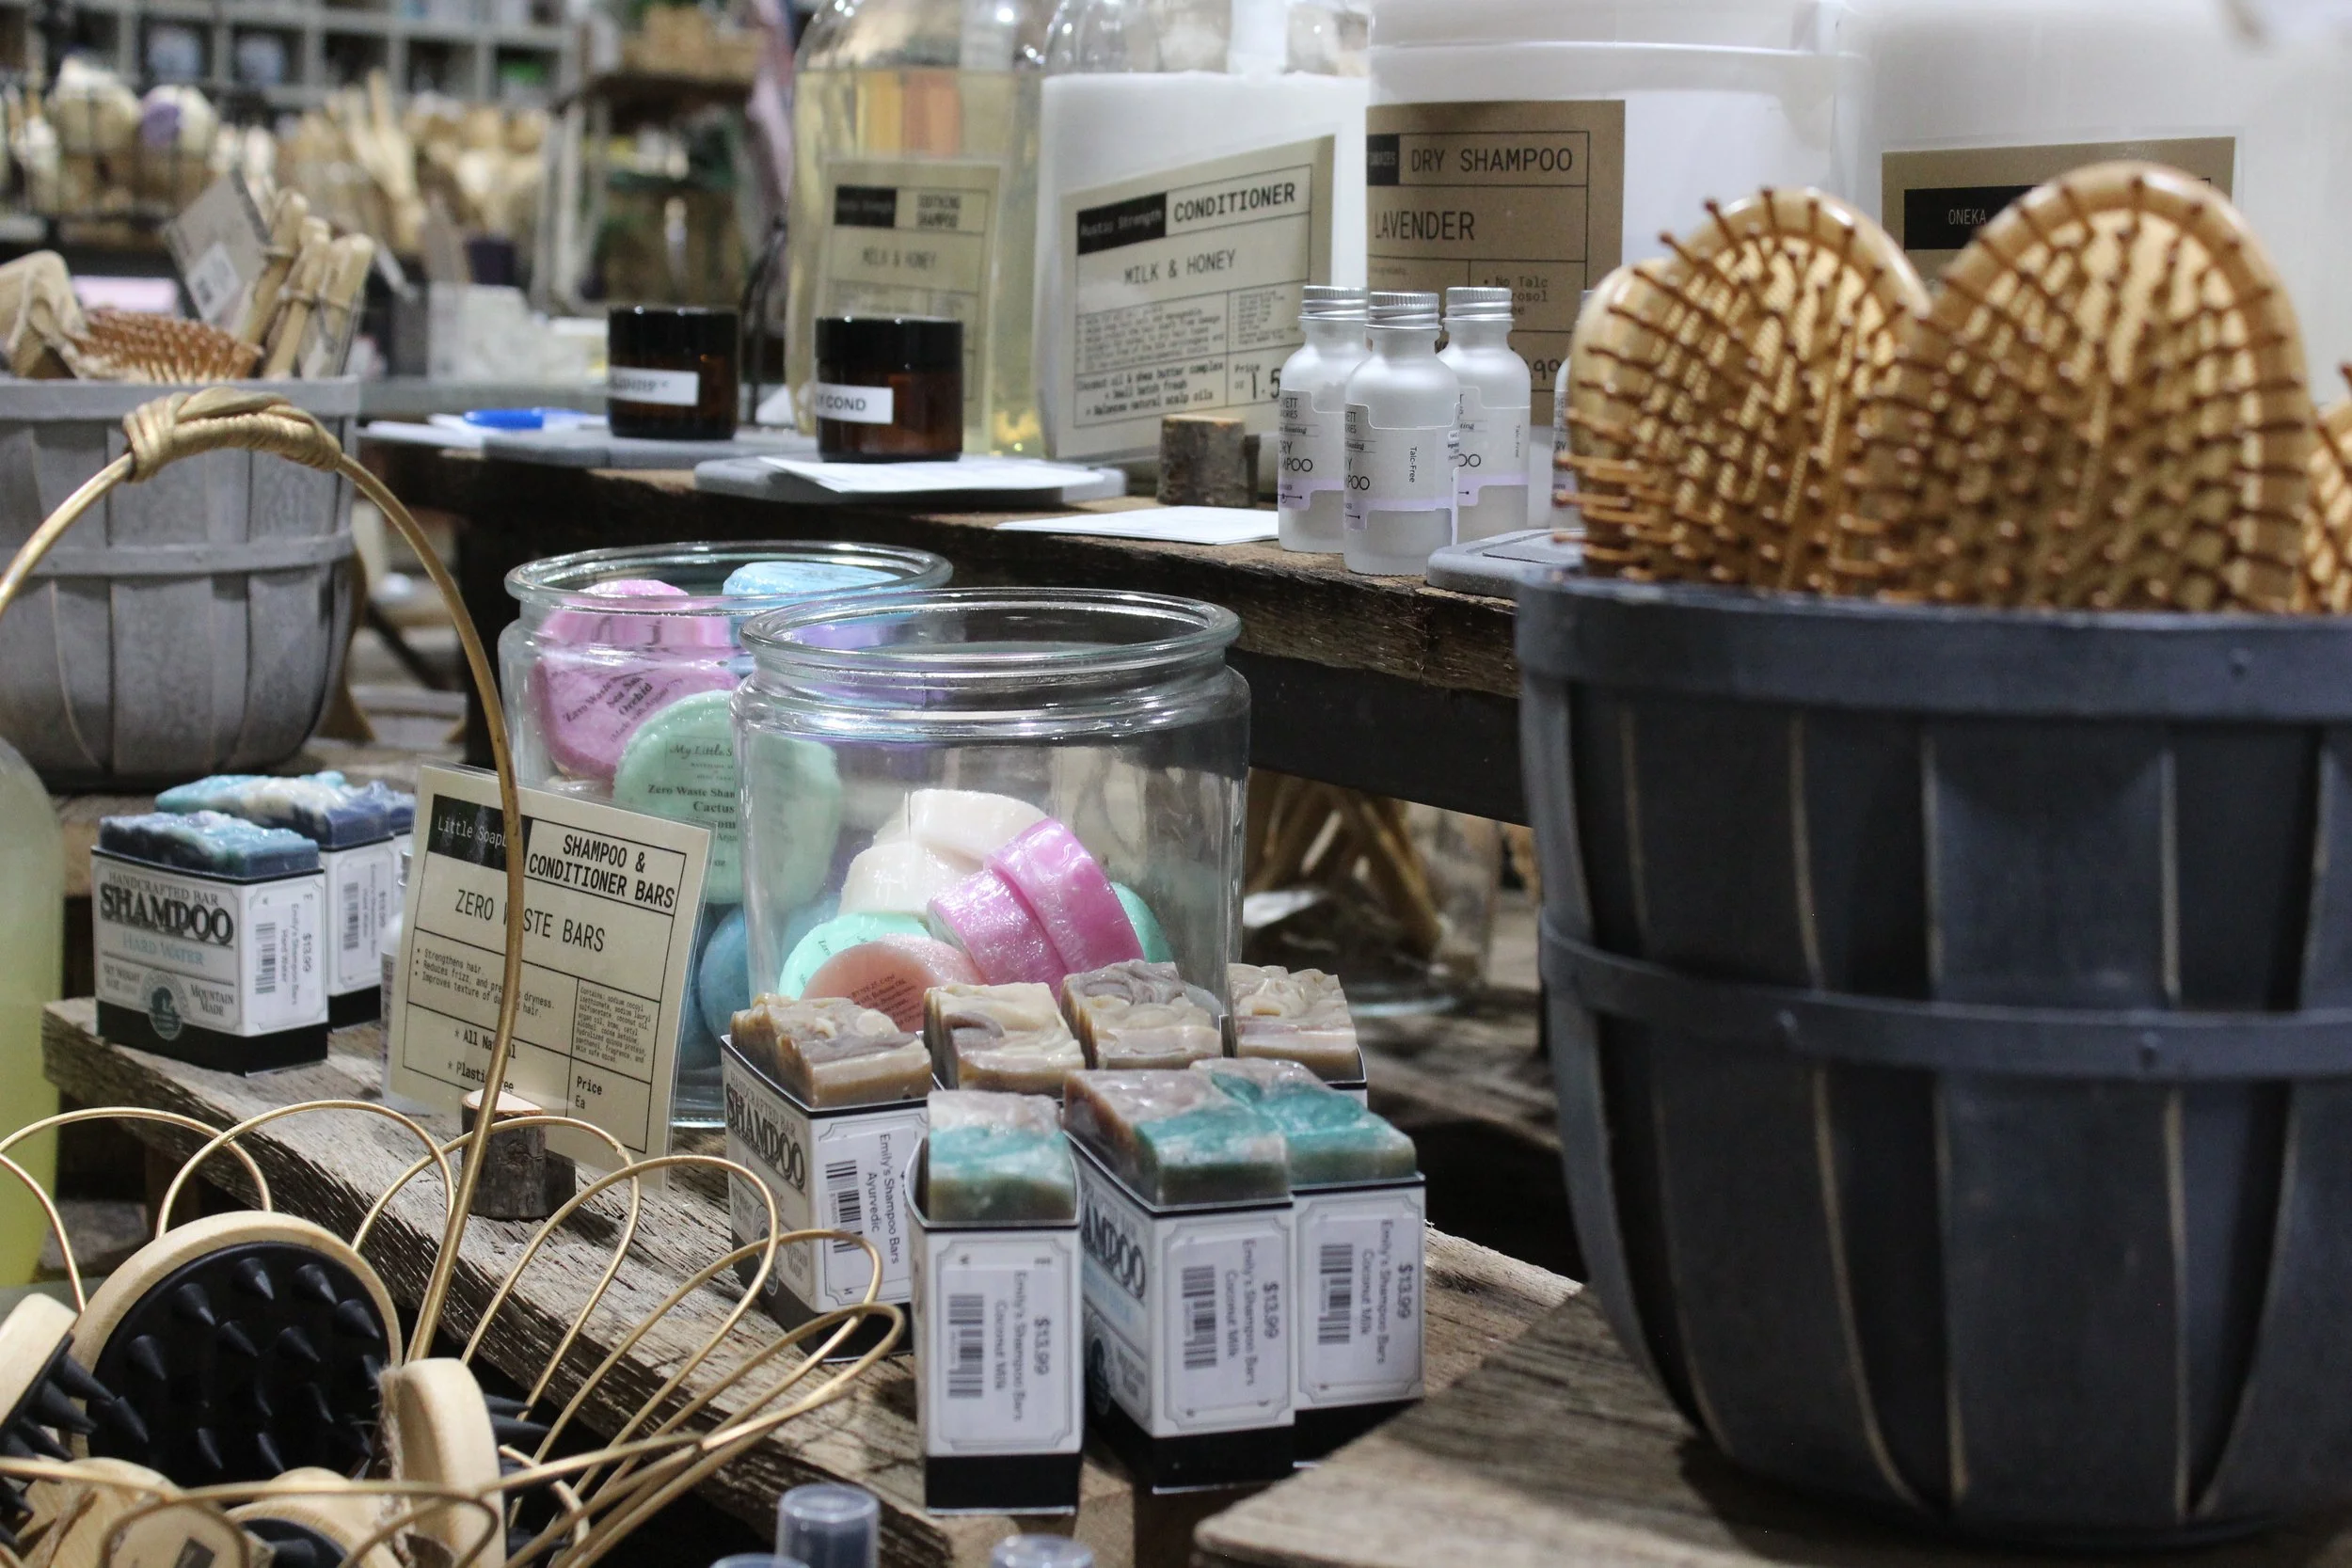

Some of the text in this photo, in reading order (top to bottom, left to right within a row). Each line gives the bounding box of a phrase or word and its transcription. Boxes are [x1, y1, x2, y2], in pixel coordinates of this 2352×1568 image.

[1411, 149, 1445, 172] DRY
[1459, 148, 1573, 173] SHAMPOO
[1174, 182, 1295, 223] CONDITIONER
[1948, 209, 1987, 227] ONEKA
[1375, 210, 1476, 241] LAVENDER
[1124, 248, 1236, 285] MILK & HONEY
[1518, 275, 1549, 288] Talc
[1511, 290, 1549, 303] rosol
[1408, 446, 1418, 483] Talc-Free
[585, 681, 612, 705] Waste
[618, 682, 654, 716] Orchid
[670, 744, 691, 760] My
[694, 743, 724, 756] Little
[647, 784, 674, 796] Zero
[675, 786, 707, 798] Waste
[692, 800, 736, 814] Cactus
[438, 815, 473, 839] Little
[563, 833, 646, 873] SHAMPOO &
[108, 871, 219, 907] HANDCRAFTED BAR
[529, 852, 675, 909] CONDITIONER BARS
[101, 881, 235, 946] SHAMPOO
[454, 889, 495, 922] ZERO
[563, 918, 605, 952] BARS
[122, 930, 205, 966] HARD WATER
[302, 932, 312, 974] $13.99
[424, 948, 464, 970] Strengthens
[189, 983, 234, 1004] MOUNTAIN
[421, 971, 451, 989] Improves
[453, 982, 480, 998] texture
[482, 990, 491, 1001] of
[522, 1003, 543, 1018] hair.
[423, 959, 449, 976] Reduces
[475, 977, 488, 989] and
[523, 990, 555, 1009] dryness.
[199, 999, 225, 1016] MADE
[462, 1030, 478, 1046] All
[456, 1061, 486, 1084] Plasti
[576, 1075, 603, 1096] Price
[575, 1095, 586, 1110] Ea
[725, 1083, 806, 1191] SHAMPOO
[866, 1172, 881, 1233] Ayurvedic
[880, 1132, 899, 1264] Emily's Shampoo Bars
[1359, 1248, 1375, 1337] Coconut Milk
[1375, 1219, 1394, 1366] Emily's Shampoo Bars
[1397, 1262, 1414, 1320] $13.99
[1225, 1270, 1240, 1360] Coconut Milk
[1241, 1239, 1260, 1387] Emily's Shampoo Bars
[1263, 1282, 1280, 1339] $13.99
[1012, 1271, 1028, 1423] Emily's Shampoo Bars
